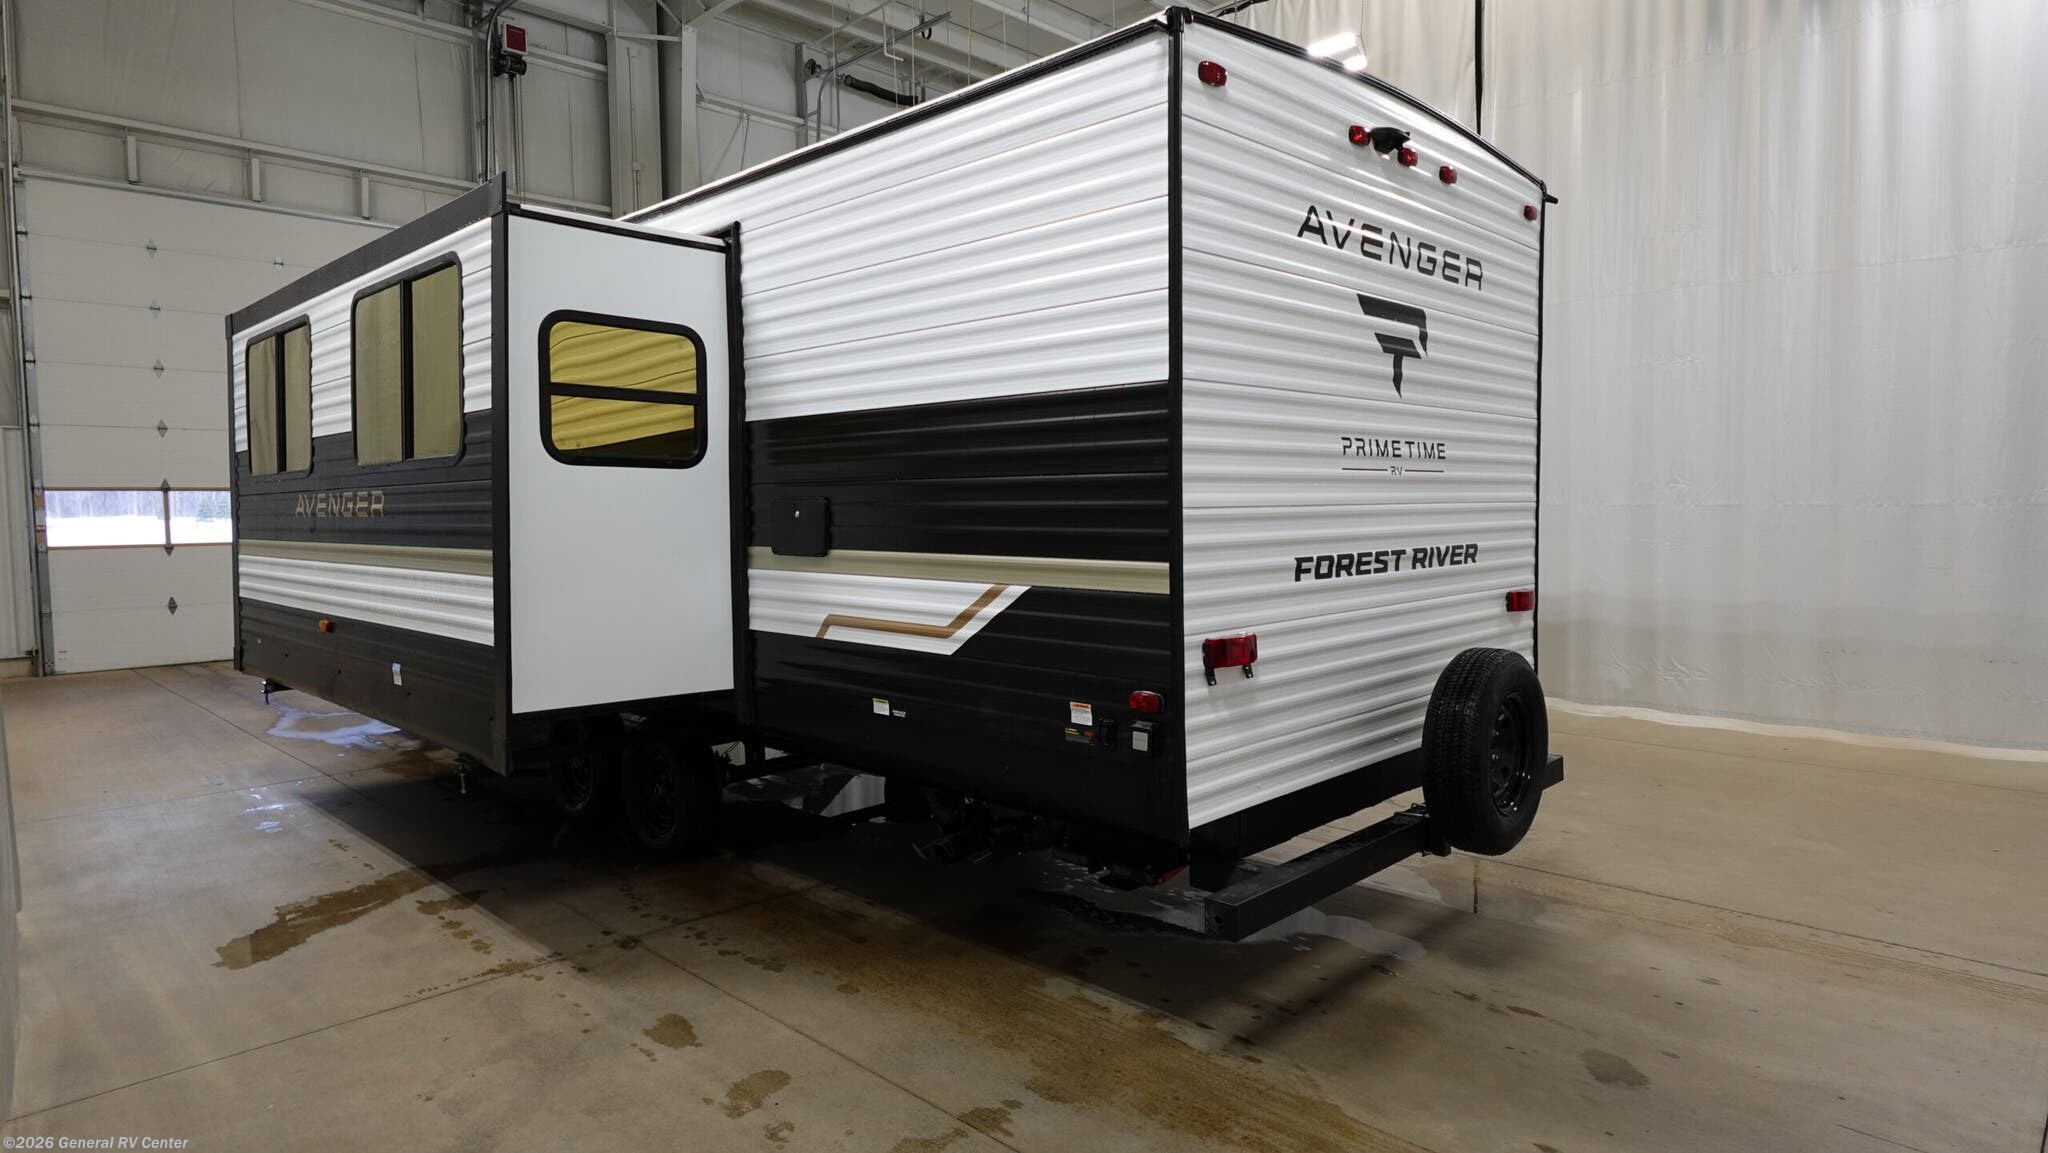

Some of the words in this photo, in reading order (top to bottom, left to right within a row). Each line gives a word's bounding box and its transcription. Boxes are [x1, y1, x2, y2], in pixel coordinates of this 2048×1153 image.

[1297, 204, 1483, 291] AVENGER
[1390, 466, 1403, 476] RV
[295, 491, 385, 518] AVENGER
[1294, 549, 1407, 582] FOREST
[1412, 543, 1479, 570] RIVER
